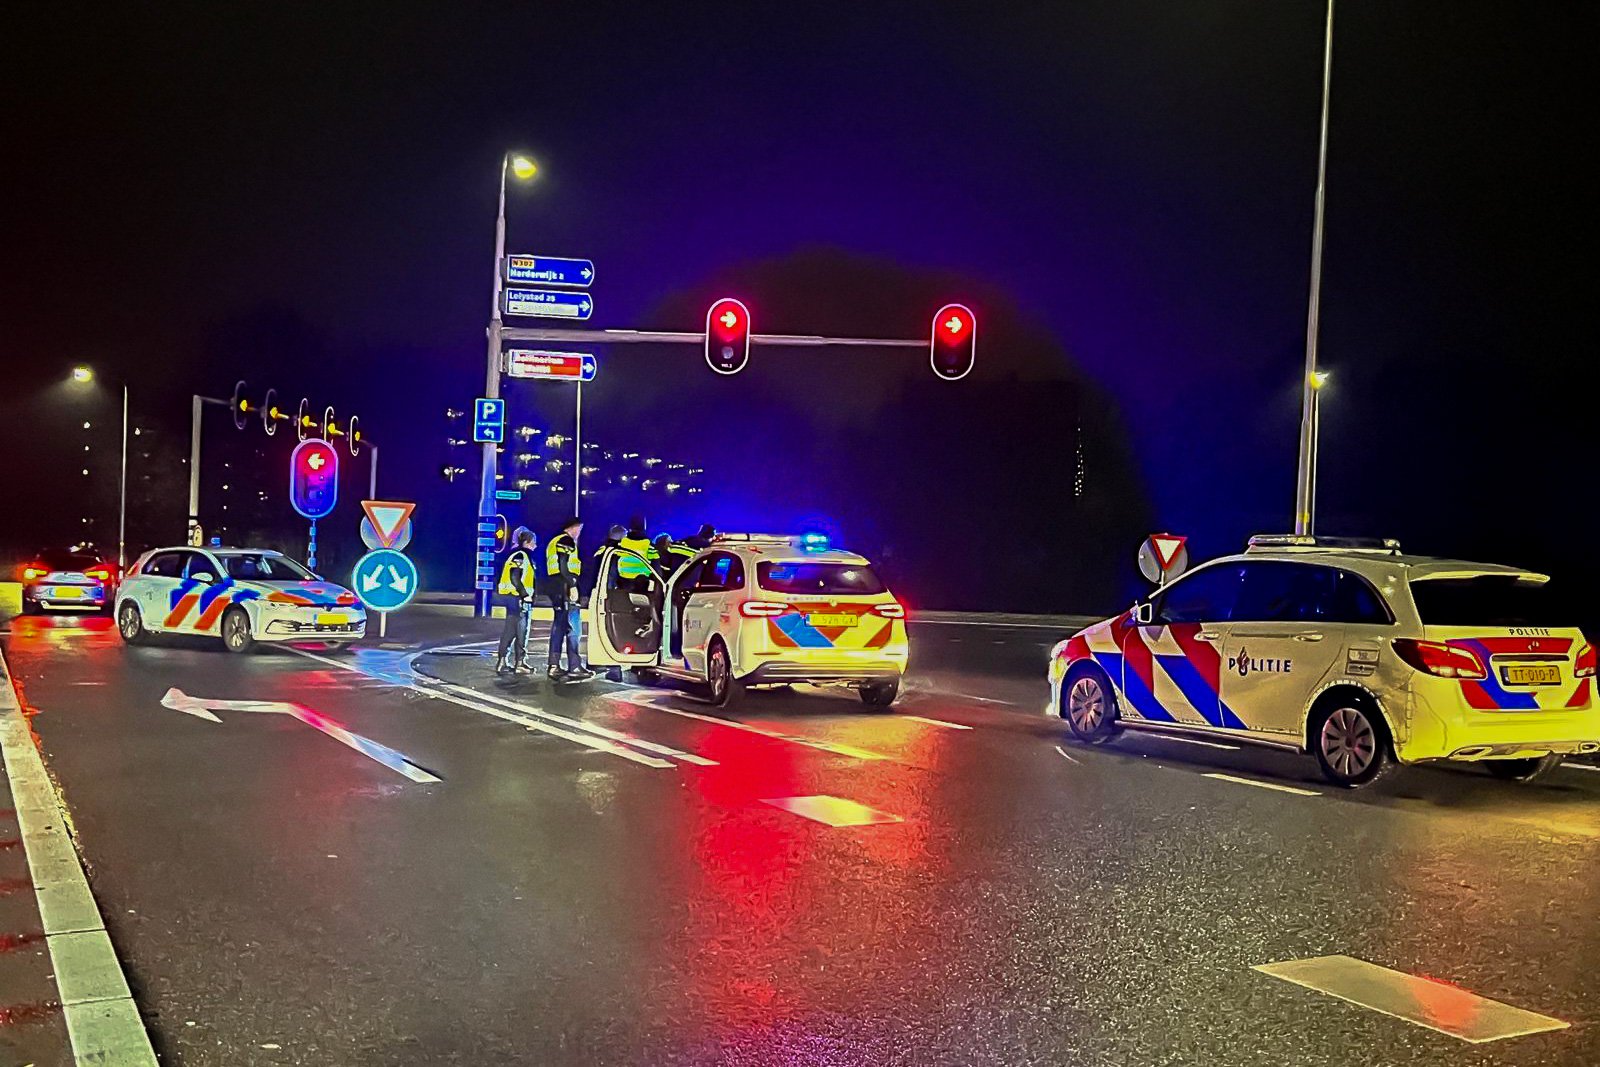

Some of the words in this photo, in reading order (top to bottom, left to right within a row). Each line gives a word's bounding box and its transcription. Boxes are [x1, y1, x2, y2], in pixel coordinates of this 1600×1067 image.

[509, 292, 544, 302] Lelystad
[482, 402, 496, 419] P
[1508, 628, 1550, 636] POLITIE
